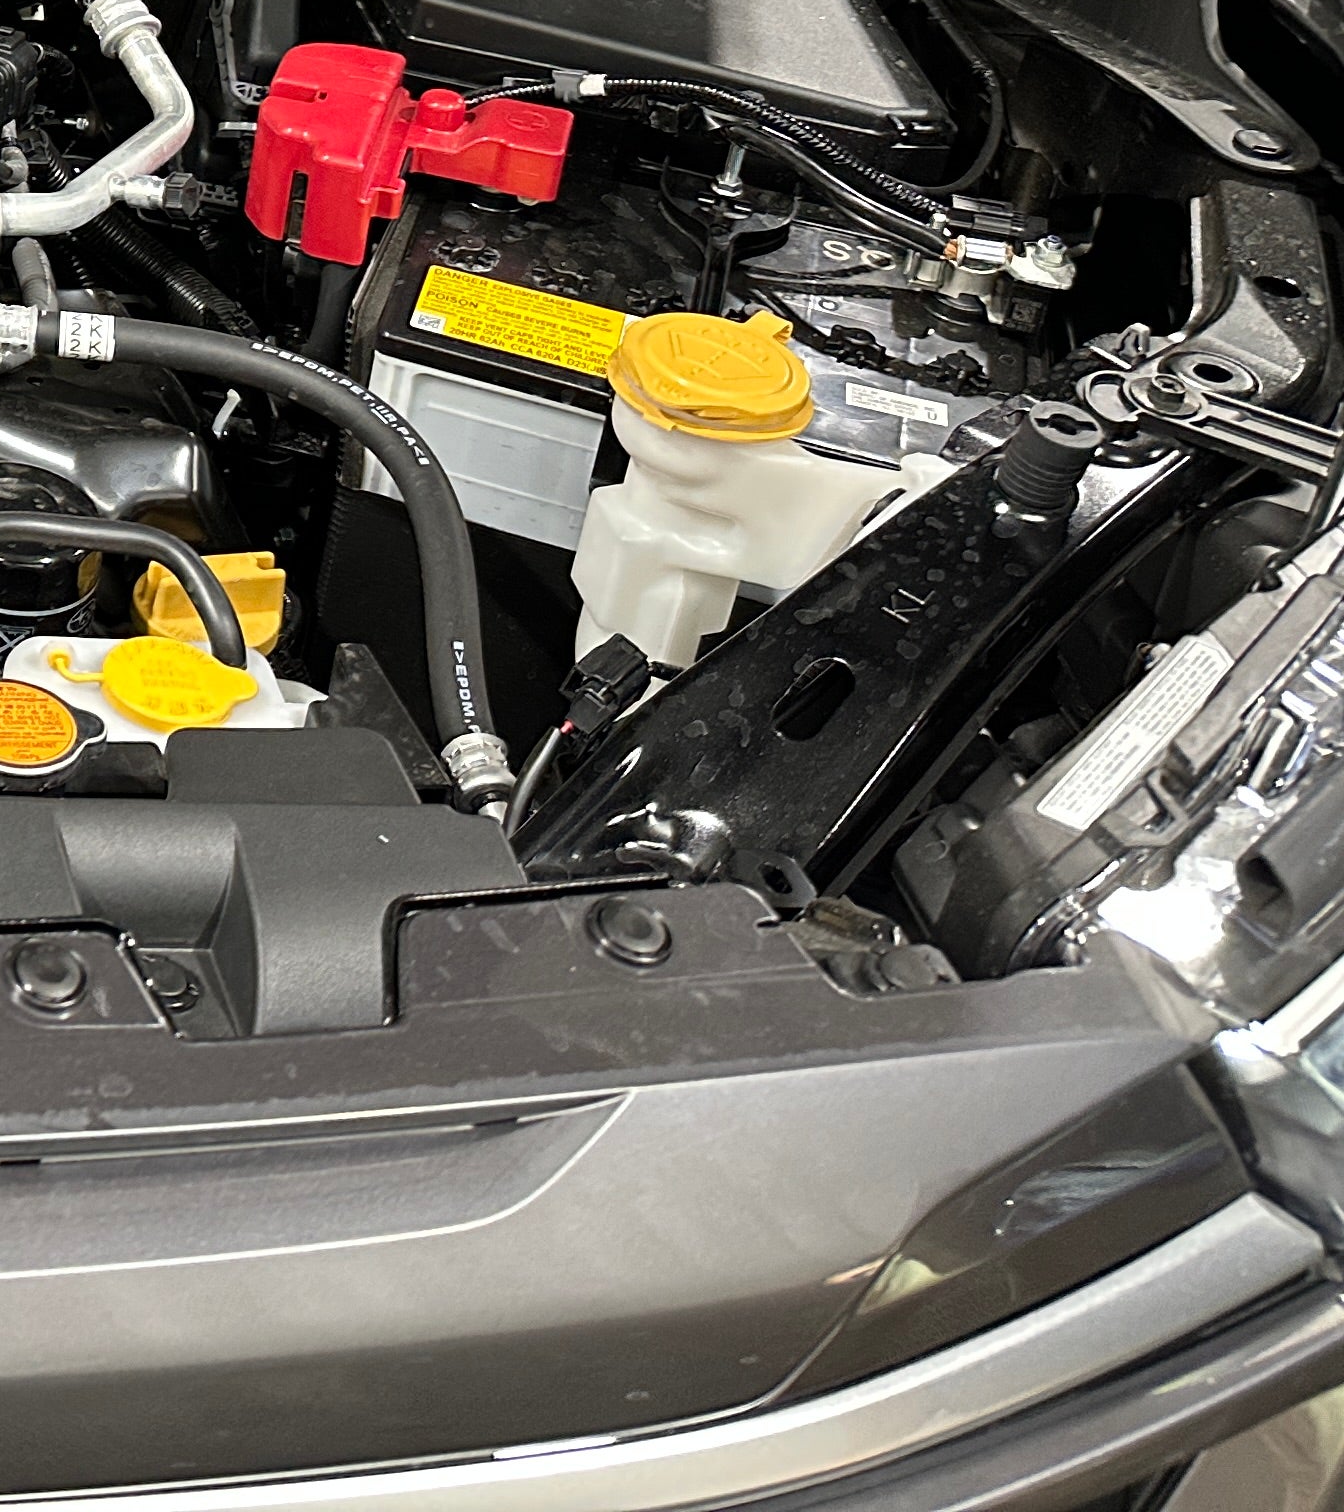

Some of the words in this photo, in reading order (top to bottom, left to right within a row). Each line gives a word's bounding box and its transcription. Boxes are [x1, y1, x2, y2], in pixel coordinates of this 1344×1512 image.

[434, 268, 489, 287] DANGER
[493, 284, 540, 300] EXPLOSIVE
[426, 290, 479, 308] POISON
[486, 306, 522, 320] CAUSES
[524, 316, 559, 329] SEVERE
[560, 325, 591, 338] BURNS
[449, 327, 477, 340] 20HR
[510, 342, 534, 355] CCA
[459, 316, 483, 326] KEEP
[563, 343, 582, 353] AND
[584, 349, 608, 360] LEVE
[881, 588, 935, 624] KL
